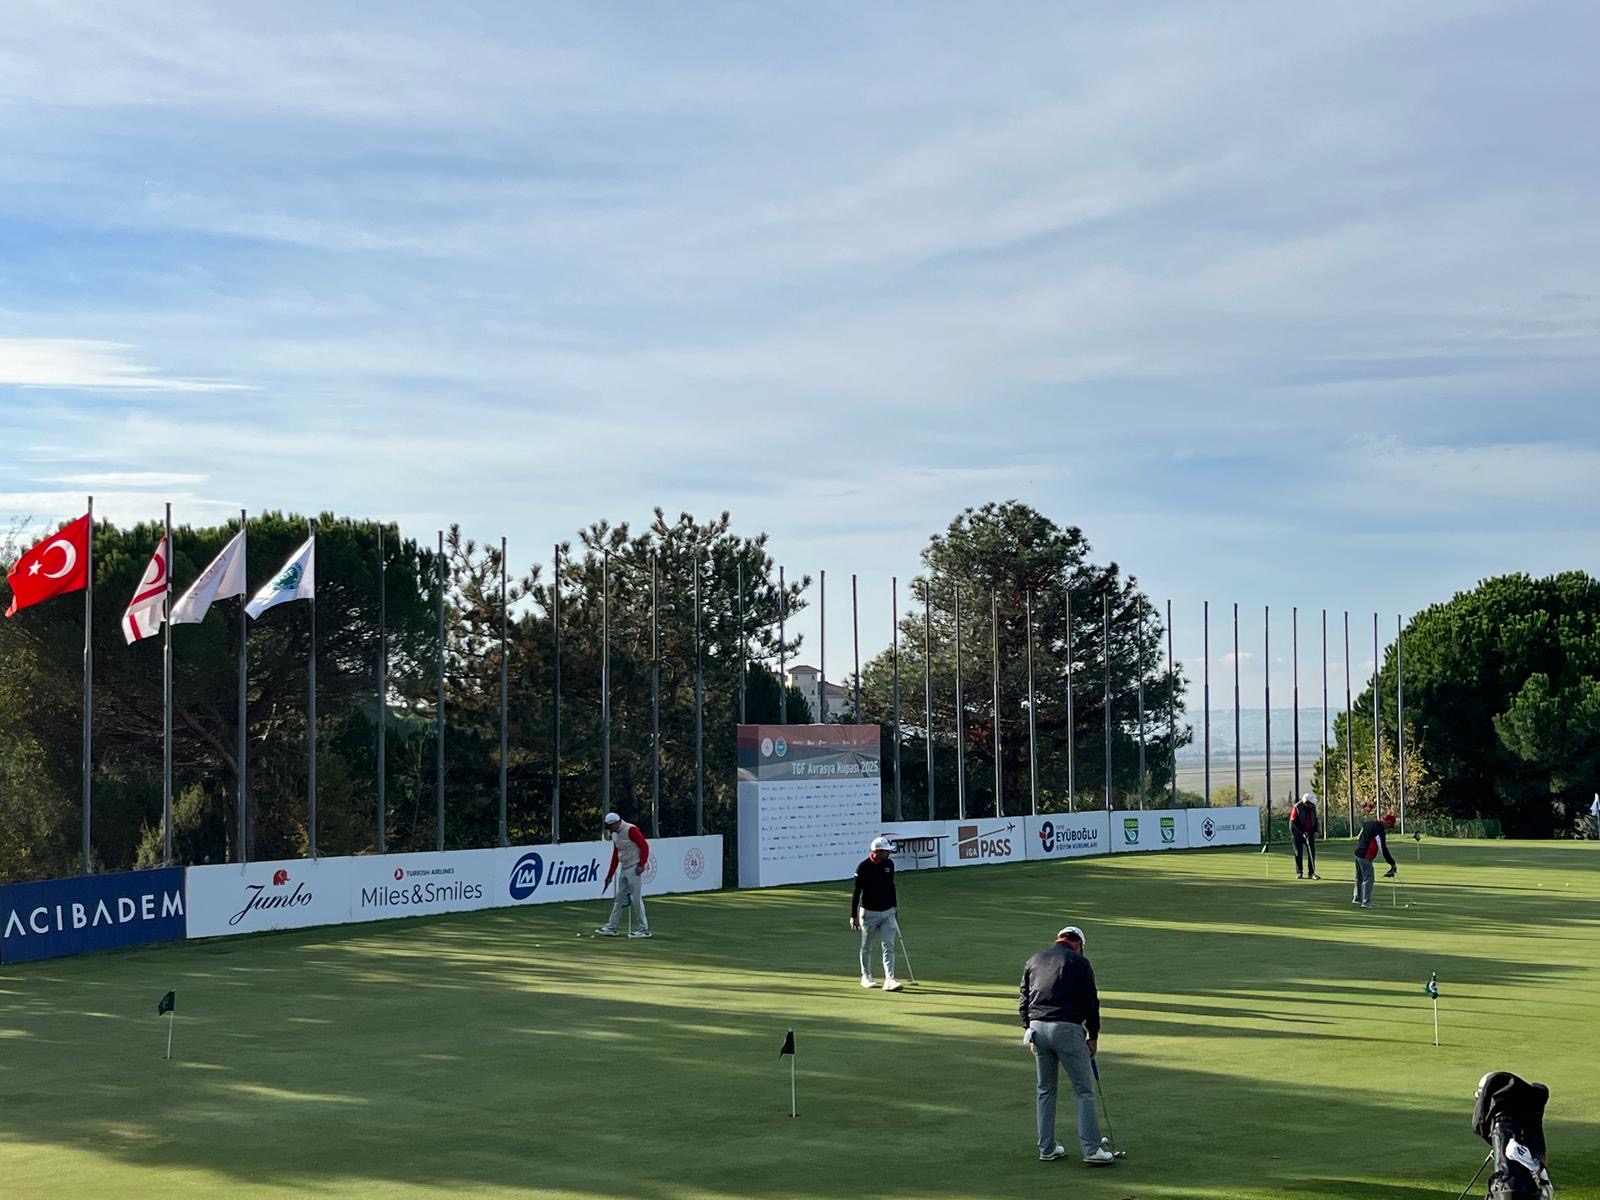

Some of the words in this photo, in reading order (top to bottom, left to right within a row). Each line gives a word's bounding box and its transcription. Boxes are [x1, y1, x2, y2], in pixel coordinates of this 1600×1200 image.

[792, 763, 806, 775] TGF
[808, 763, 835, 776] Avrasya
[837, 762, 860, 776] Kupası
[861, 761, 879, 773] 2025
[1056, 828, 1098, 842] EYÜBOĞLU
[980, 838, 1012, 858] PASS
[406, 869, 430, 877] TURKISH
[430, 867, 455, 876] AIRLINES
[546, 858, 600, 886] Limak
[229, 881, 313, 926] Jumbo
[362, 880, 483, 908] Miles&Smiles
[4, 890, 184, 939] ACIBADEM
